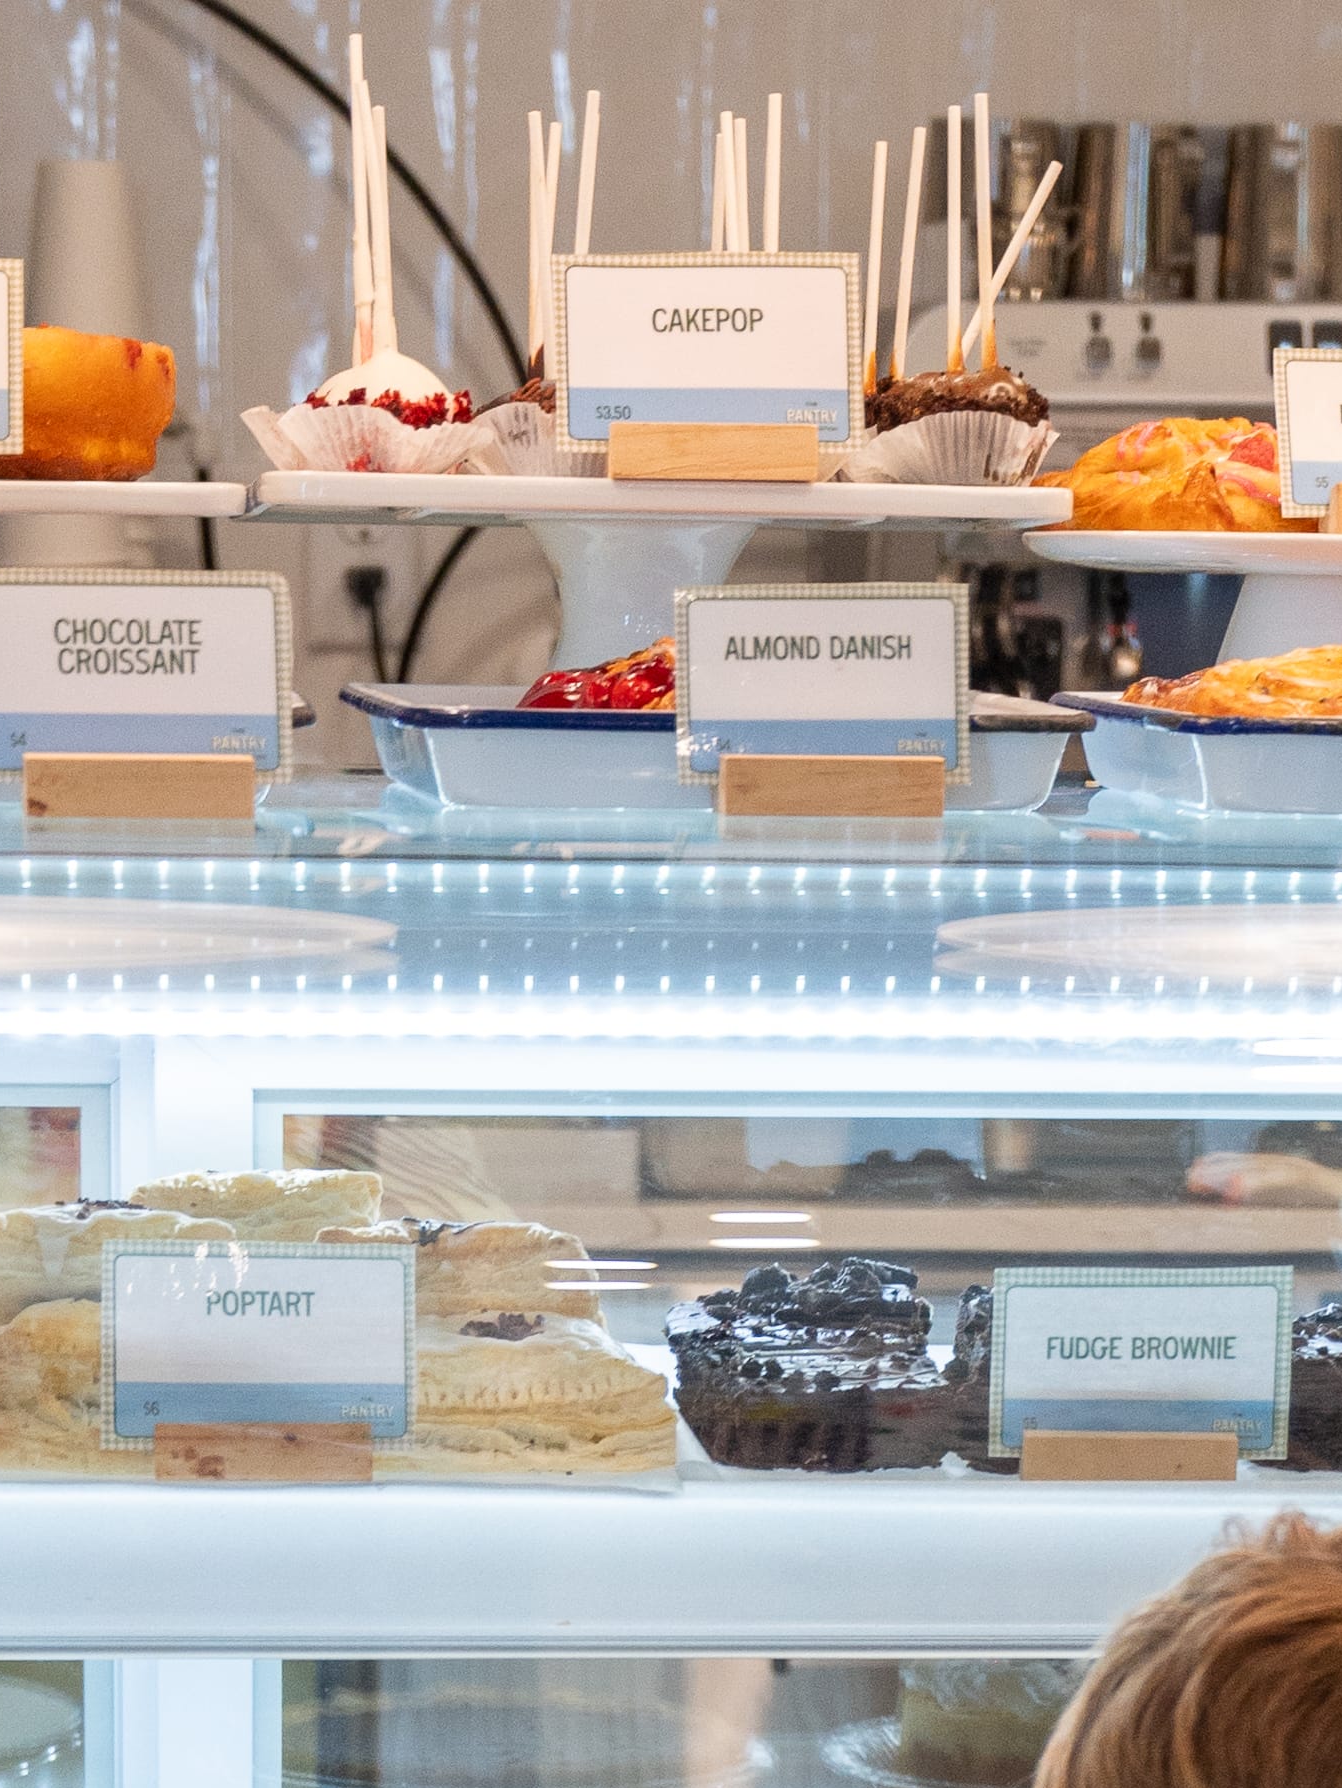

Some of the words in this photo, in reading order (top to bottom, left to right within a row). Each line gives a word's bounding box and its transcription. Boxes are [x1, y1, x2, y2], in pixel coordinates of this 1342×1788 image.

[651, 307, 765, 333] CAKEPOP
[595, 405, 632, 420] $3.50
[786, 408, 839, 423] PANTRY
[54, 618, 203, 646] CHOCOLATE
[724, 635, 821, 661] ALMOND
[830, 634, 912, 660] DANISH
[58, 649, 201, 675] CROISSANT
[207, 1290, 315, 1317] POPTART
[1046, 1336, 1123, 1360] FUDGE
[1131, 1335, 1237, 1360] BROWNIE
